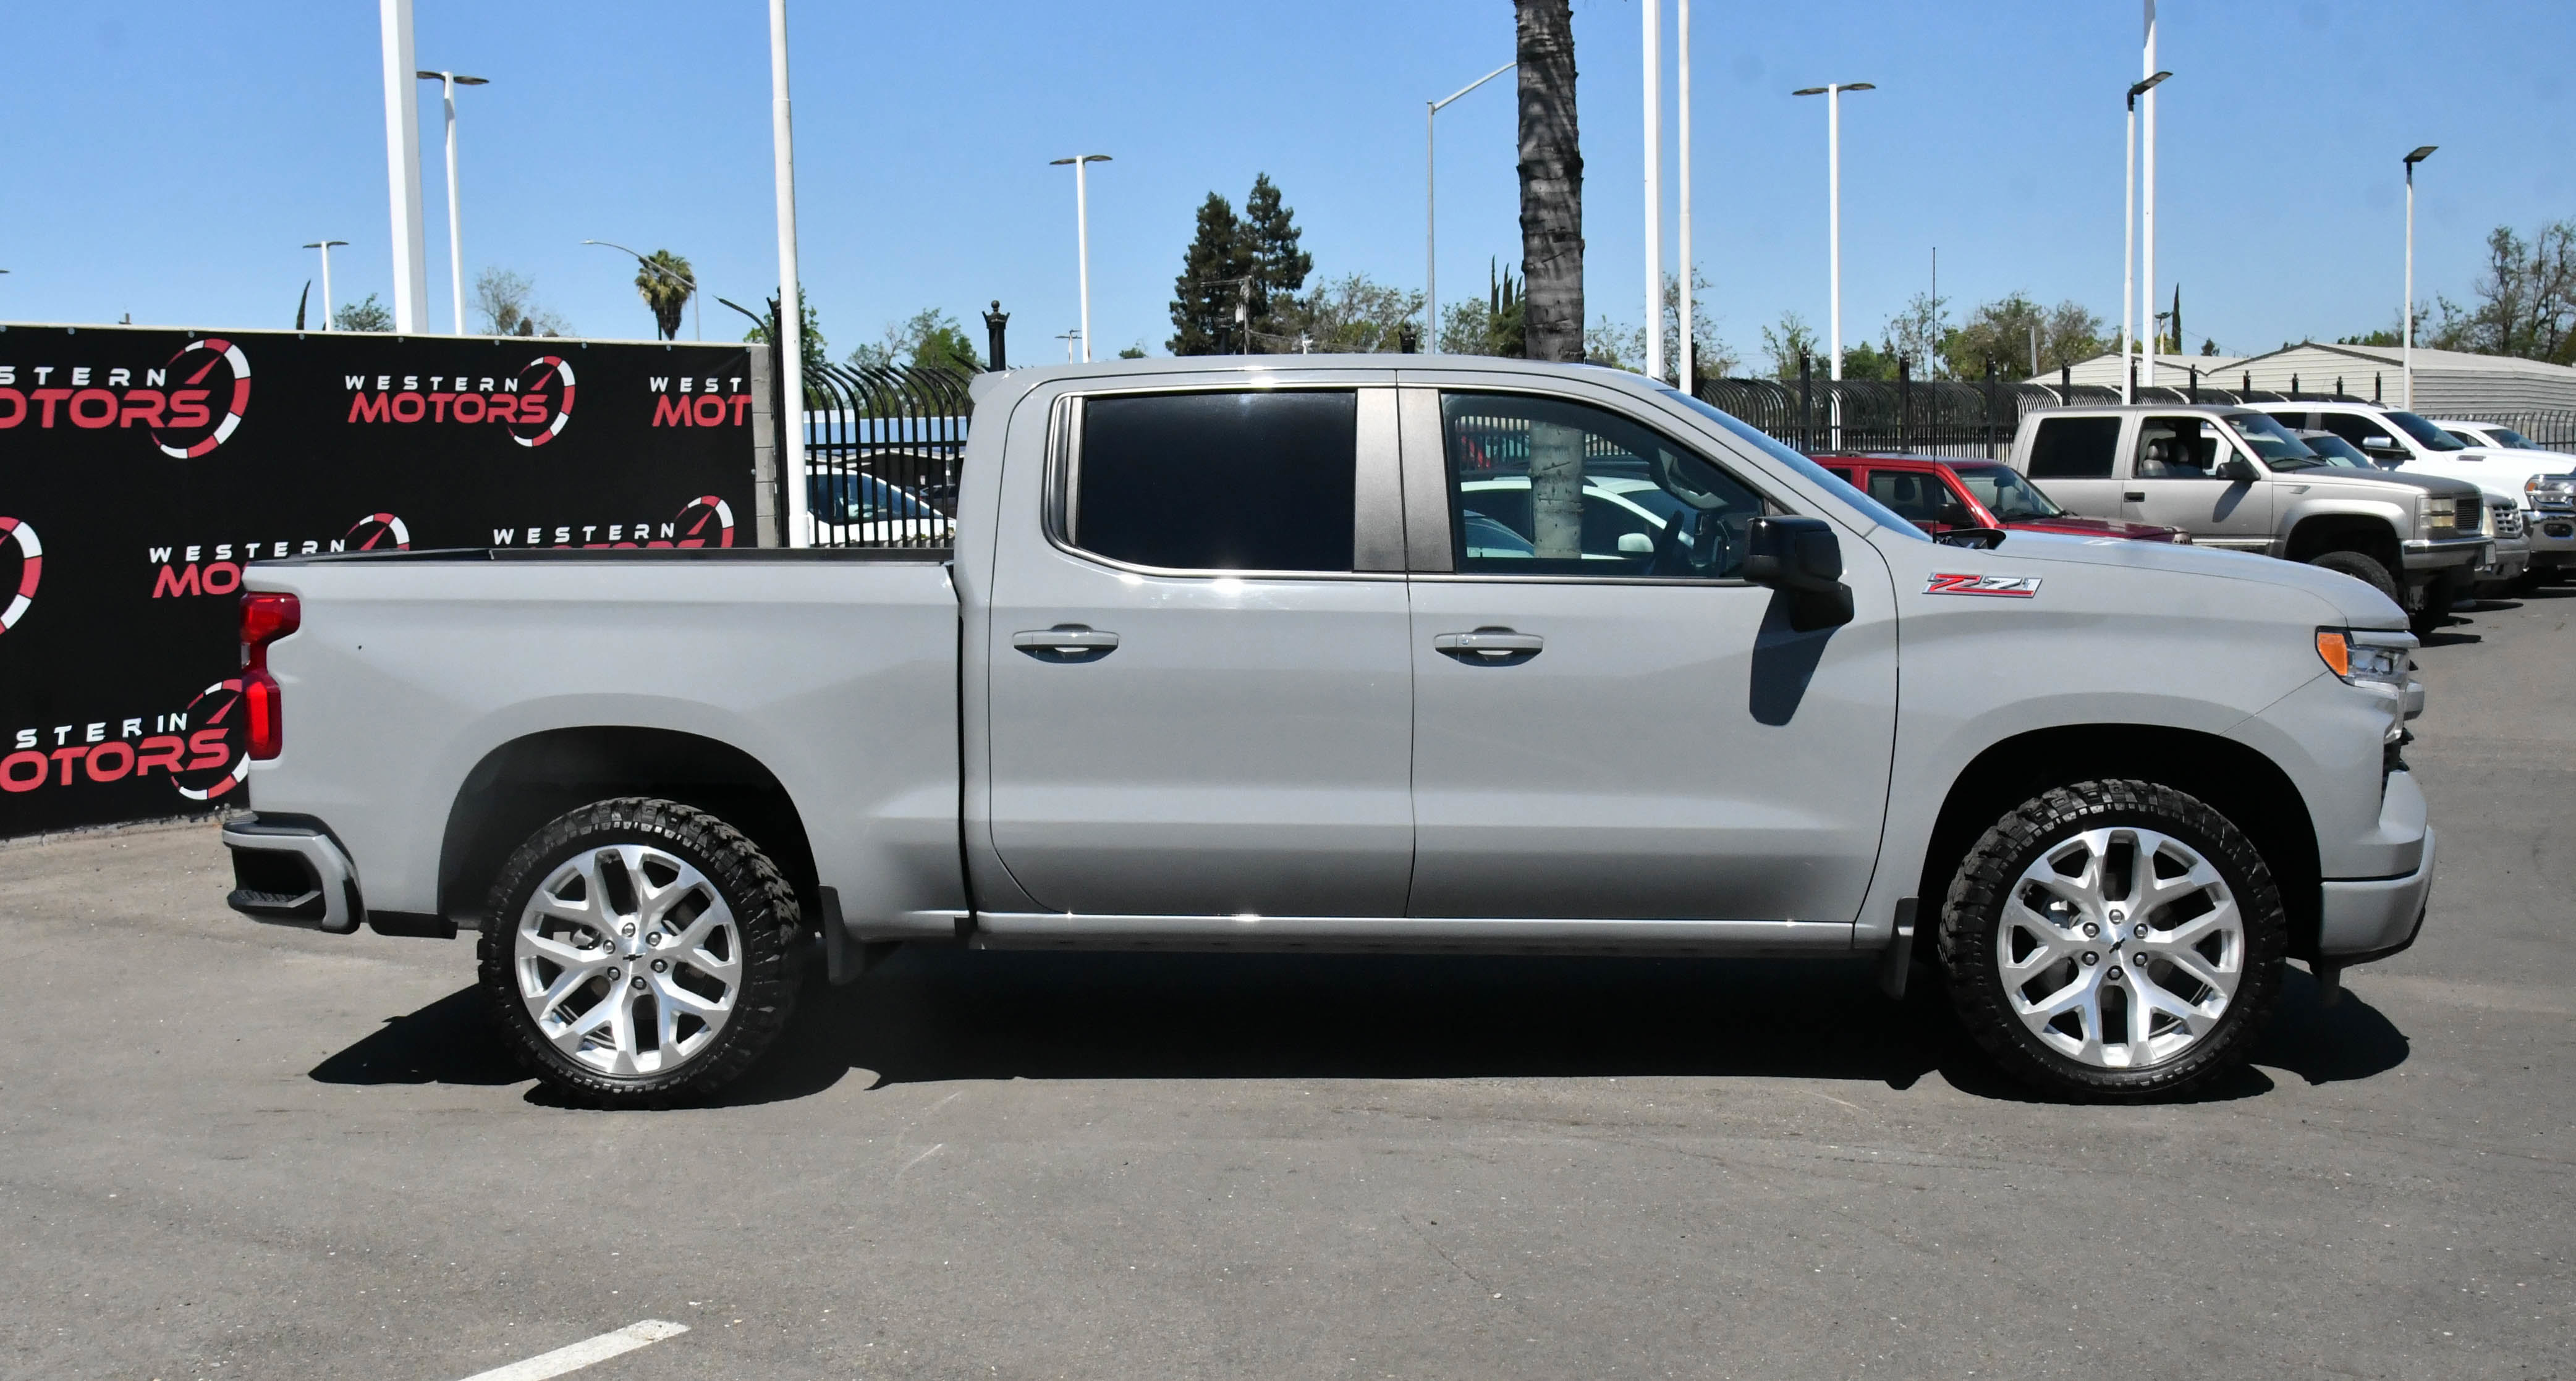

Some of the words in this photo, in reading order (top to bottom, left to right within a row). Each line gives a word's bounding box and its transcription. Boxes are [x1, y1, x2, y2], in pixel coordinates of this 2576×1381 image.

[345, 375, 518, 392] WESTERN
[650, 376, 742, 392] WEST
[348, 392, 548, 423] MOTORS
[652, 394, 752, 427] MOT
[493, 522, 674, 545] WESTERN
[149, 539, 345, 564] WESTERN
[152, 561, 248, 598] MO
[1921, 572, 2042, 598] Z71
[0, 728, 229, 792] OTORS
